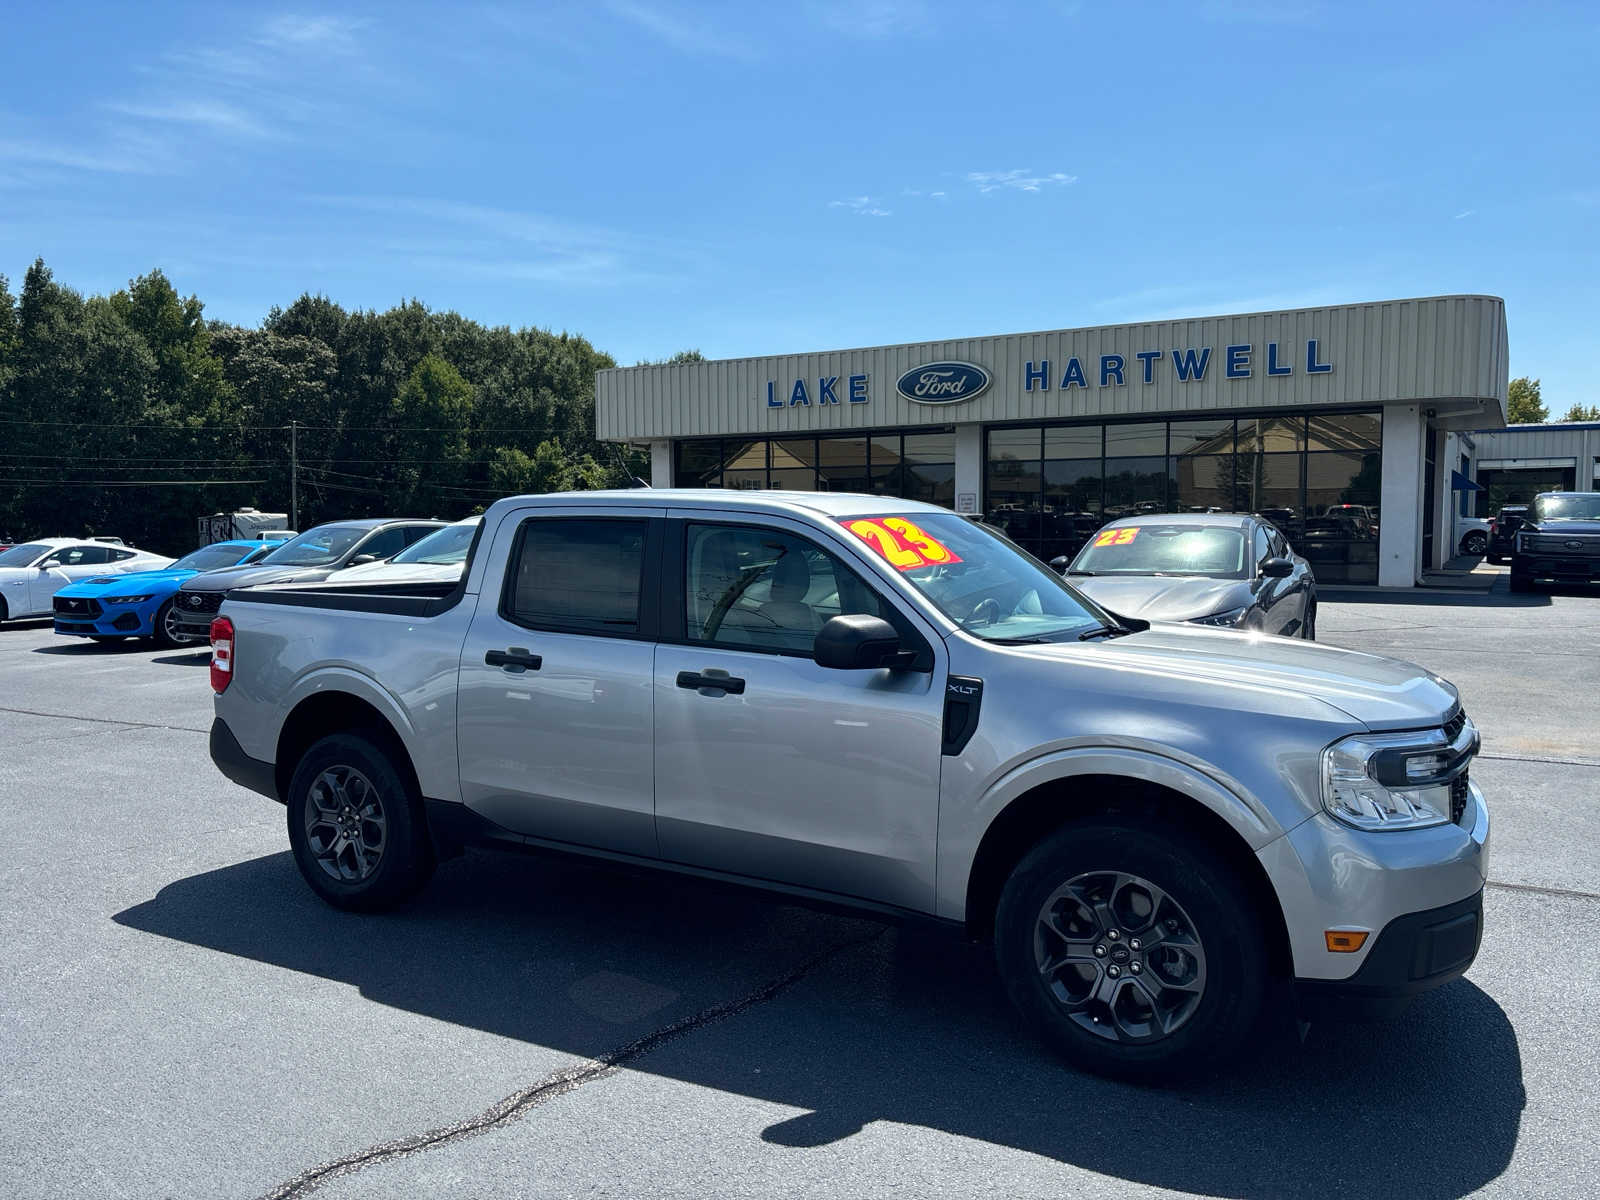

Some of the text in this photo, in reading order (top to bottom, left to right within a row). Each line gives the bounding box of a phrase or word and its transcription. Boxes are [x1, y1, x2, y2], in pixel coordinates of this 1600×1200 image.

[767, 339, 1333, 408] LAKE Ford HARTWELL
[850, 517, 951, 568] 23
[1095, 528, 1137, 546] 23
[947, 684, 979, 695] XLT
